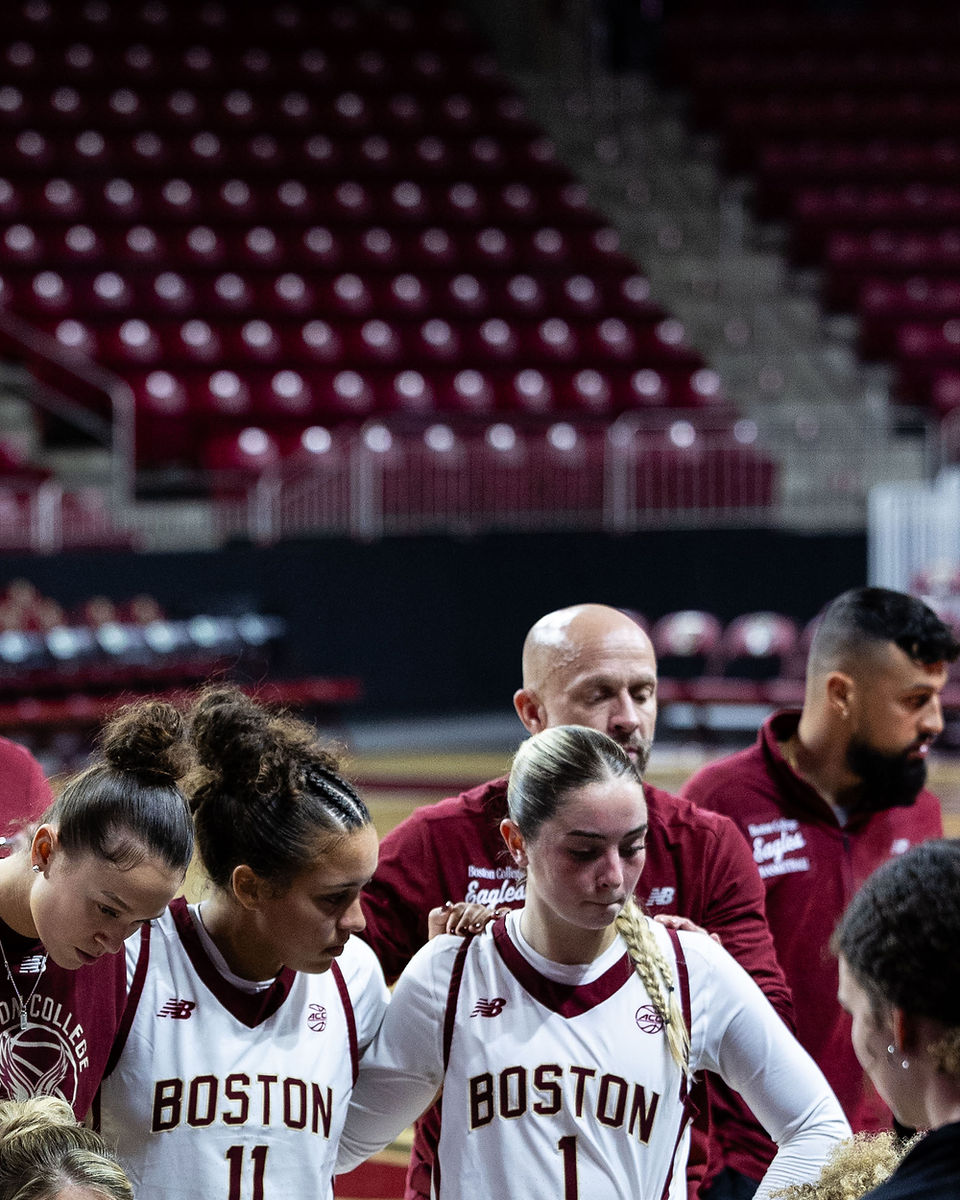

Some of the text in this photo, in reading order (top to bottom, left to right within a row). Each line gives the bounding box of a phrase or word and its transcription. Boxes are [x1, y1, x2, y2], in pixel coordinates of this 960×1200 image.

[30, 993, 90, 1073] COLLEGE
[150, 1073, 334, 1141] BOSTON
[468, 1064, 662, 1146] BOSTON
